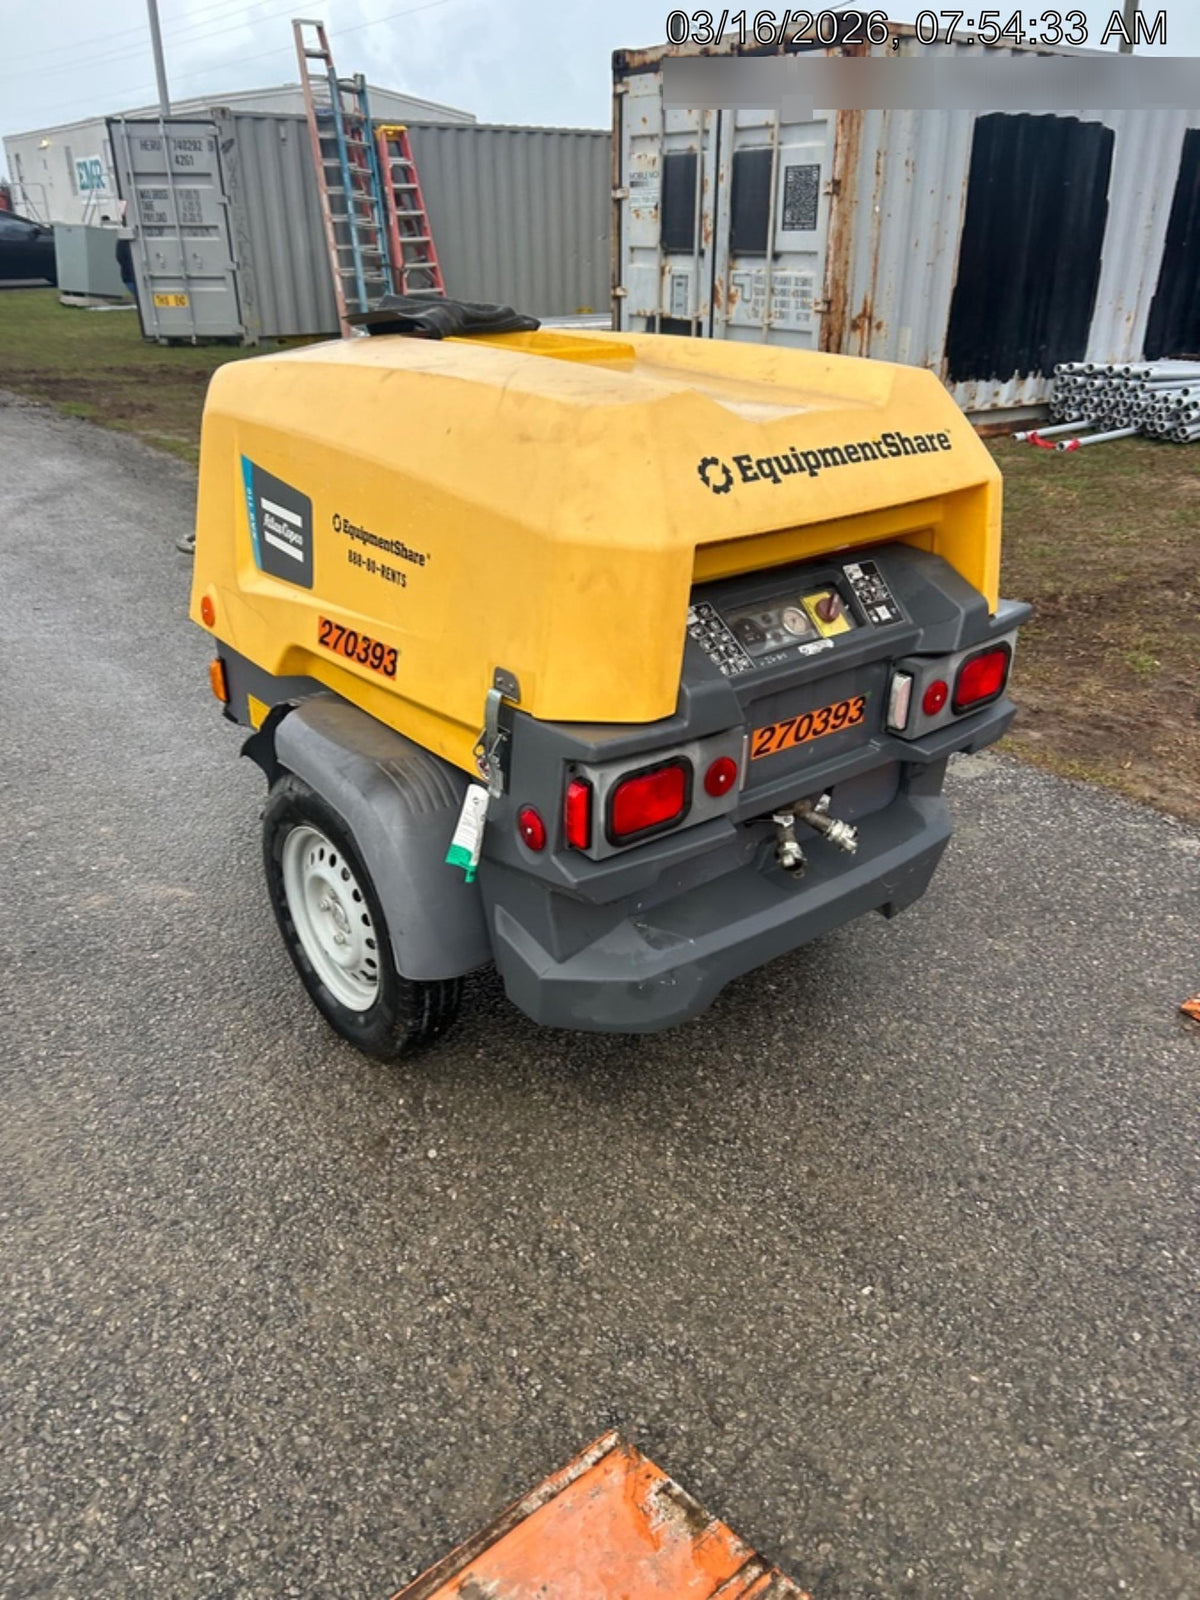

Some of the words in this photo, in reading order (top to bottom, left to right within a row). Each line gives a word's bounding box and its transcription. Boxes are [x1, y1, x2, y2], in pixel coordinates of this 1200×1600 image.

[732, 431, 952, 484] EquipmentShare
[342, 518, 426, 567] EquipmentShare
[347, 548, 407, 588] 888-80-RENTS
[318, 619, 399, 677] 270393
[752, 696, 867, 758] 270393
